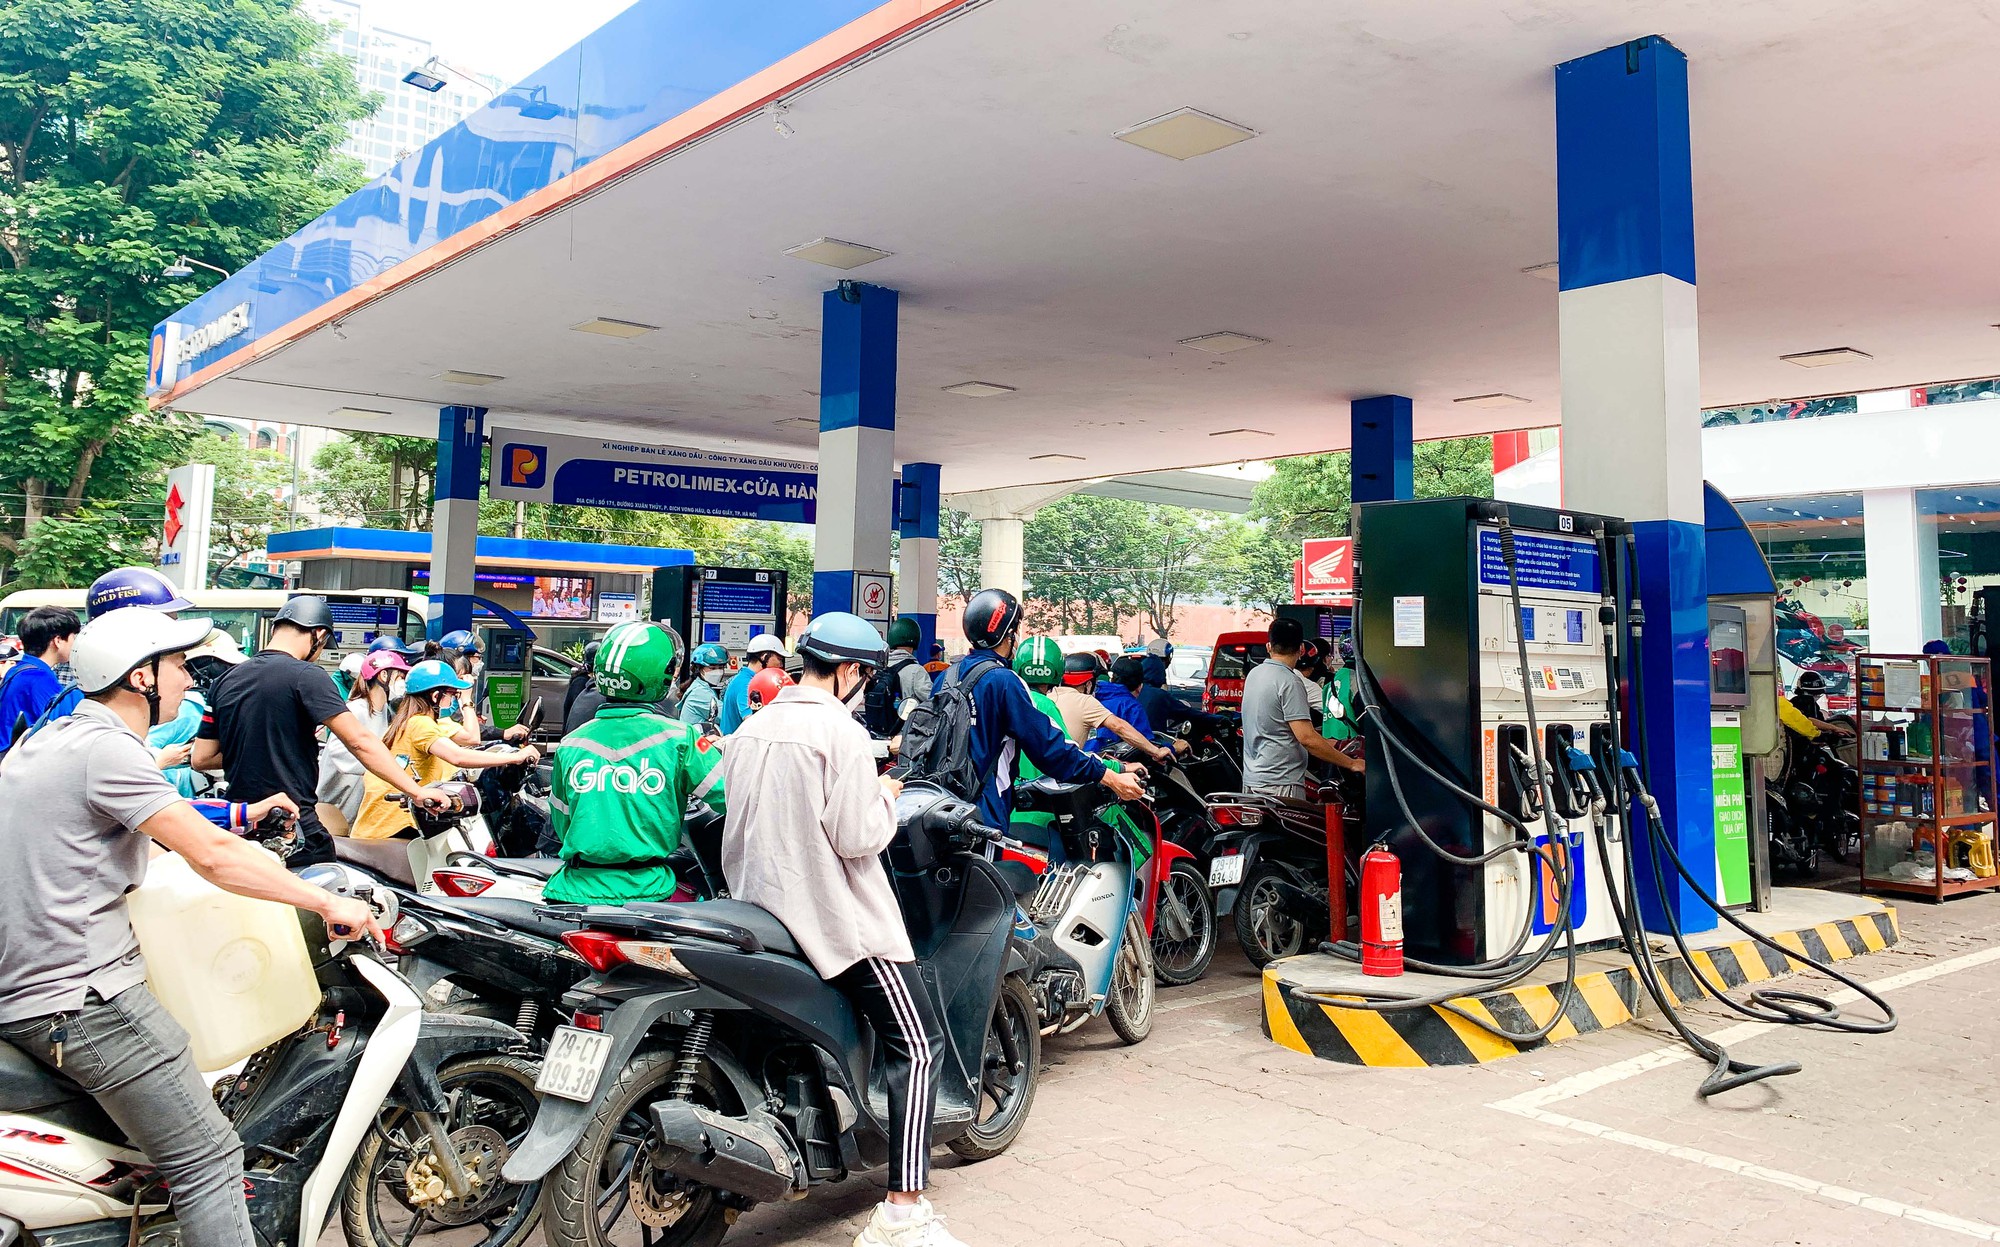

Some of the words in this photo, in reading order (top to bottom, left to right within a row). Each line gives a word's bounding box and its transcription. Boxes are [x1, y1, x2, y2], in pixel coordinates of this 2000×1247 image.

[612, 444, 639, 453] NGHIỆP
[708, 454, 726, 462] CÔNG
[1561, 519, 1571, 530] 05
[92, 593, 116, 606] GOLD
[118, 589, 141, 599] FISH
[1024, 666, 1051, 676] Grab
[597, 672, 631, 690] Grab
[1230, 688, 1243, 697] BÁO
[570, 758, 665, 796] Grab
[1278, 811, 1309, 820] VISION
[1091, 892, 1115, 902] HONDA
[554, 1032, 602, 1064] 29-C1
[542, 1061, 596, 1095] 199.38
